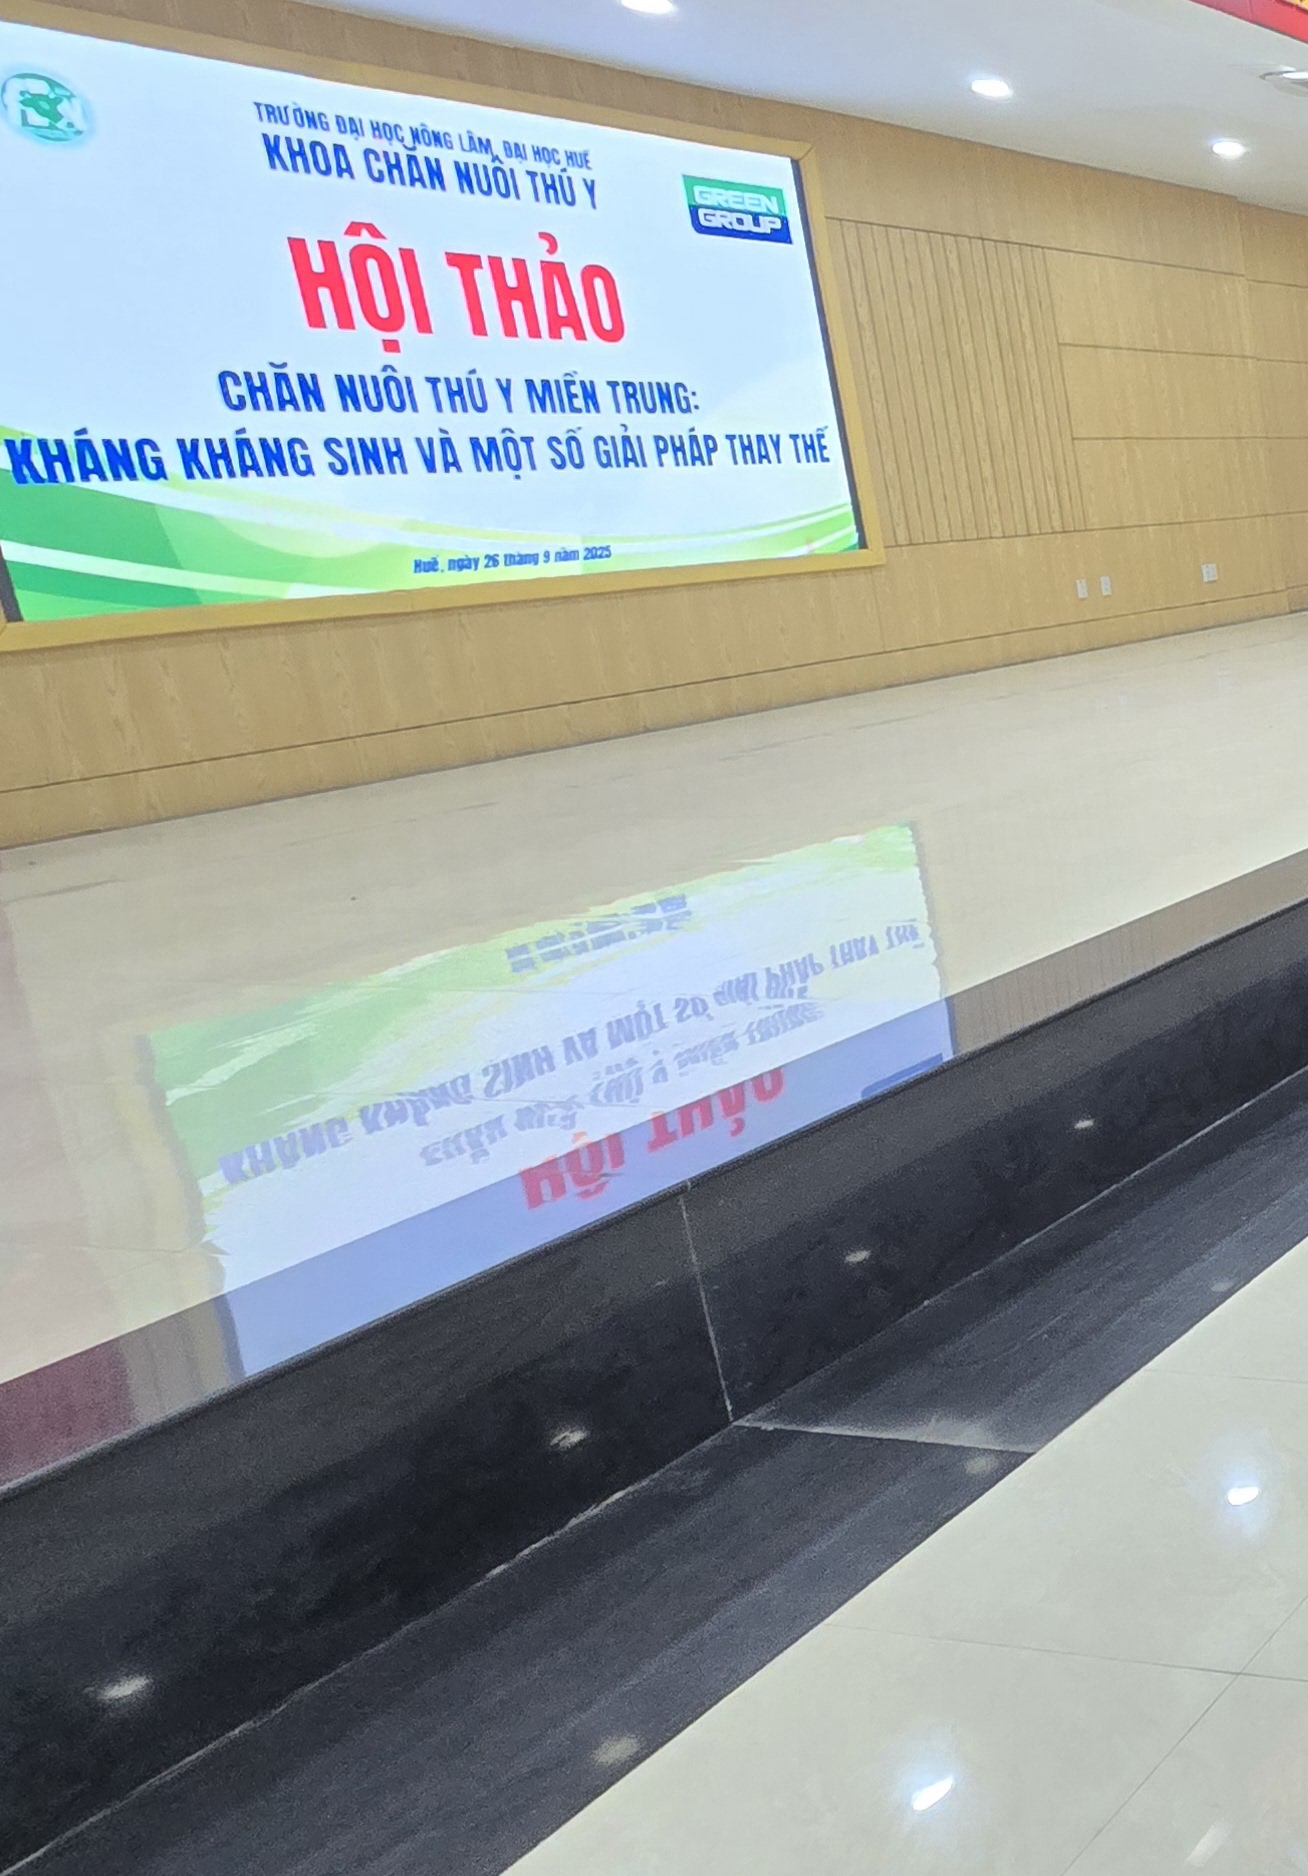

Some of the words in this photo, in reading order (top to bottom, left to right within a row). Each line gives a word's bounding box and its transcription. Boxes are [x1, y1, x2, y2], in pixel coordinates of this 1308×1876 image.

[253, 101, 329, 132] TRƯỜNG
[335, 114, 364, 142] ĐẠI
[371, 119, 404, 147] HỌC
[410, 123, 454, 151] NÔNG
[503, 140, 527, 165] ĐẠI
[532, 144, 561, 170] HỌC
[565, 148, 593, 171] HUẾ
[262, 132, 355, 180] KHOA
[363, 144, 446, 191] CHĂN
[453, 153, 521, 200] NUÔI
[525, 167, 577, 207] THÚ
[582, 178, 597, 210] Y
[693, 184, 780, 214] GREEN
[697, 207, 782, 234] GROUP
[287, 221, 434, 353] HỘI
[444, 231, 626, 343] THẢO
[217, 362, 322, 412] CHĂN
[334, 365, 419, 413] NUÔI
[425, 369, 489, 413] THÚ
[494, 377, 513, 413] Y
[524, 370, 601, 414] MIỀN
[606, 380, 700, 414] TRUNG:
[3, 427, 169, 485] KHÁNG
[176, 427, 315, 480] KHÁNG
[323, 436, 409, 476] SINH
[415, 428, 463, 474] VÀ
[469, 428, 537, 480] MỘT
[546, 426, 585, 471] SỐ
[594, 424, 648, 469] GIẢI
[653, 427, 719, 468] PHÁP
[725, 433, 783, 466] THAY
[789, 425, 831, 465] THẾ
[447, 554, 480, 572] ngày
[484, 554, 500, 568] 26
[504, 551, 540, 567] tháng
[543, 551, 550, 564] 9
[554, 547, 580, 563] năm
[583, 545, 612, 561] 2025
